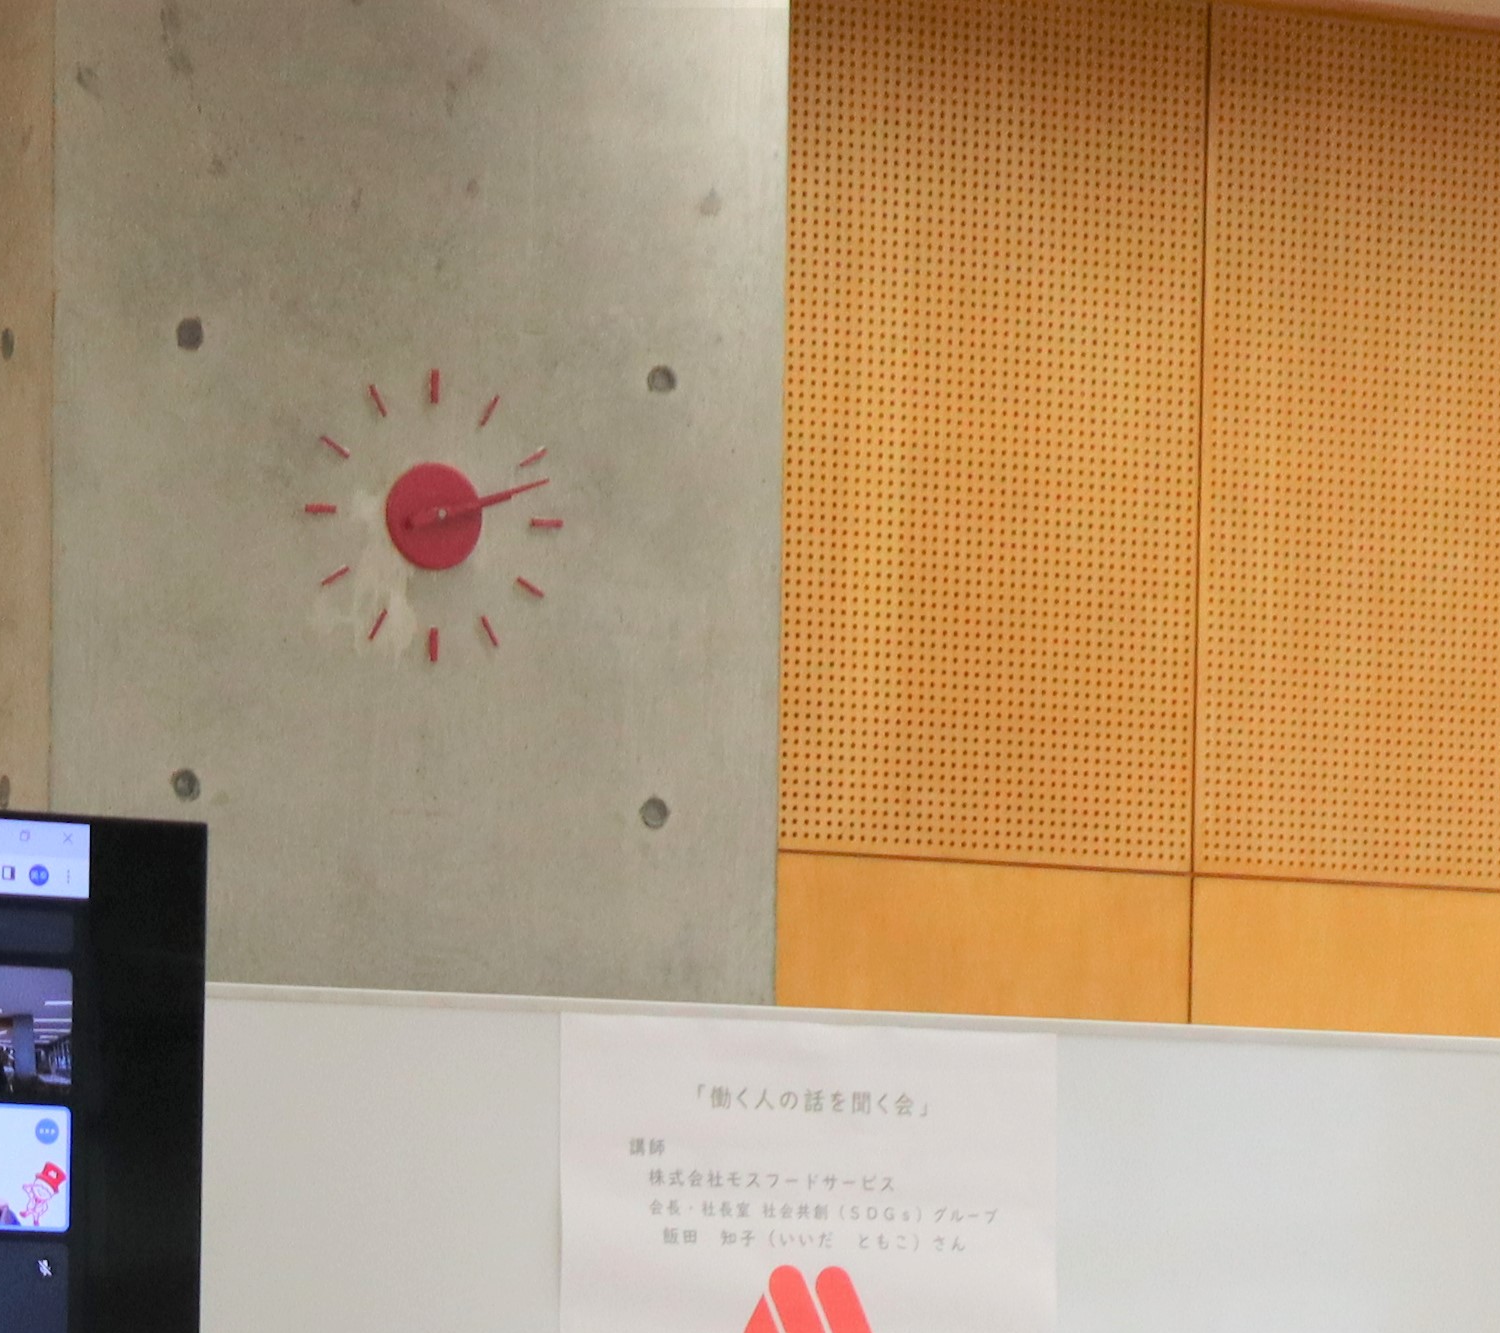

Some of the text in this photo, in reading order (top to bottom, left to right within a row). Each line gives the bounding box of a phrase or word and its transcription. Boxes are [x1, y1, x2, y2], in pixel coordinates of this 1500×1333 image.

[697, 1084, 929, 1118] 「働く人の話を聞く会」
[629, 1138, 665, 1156] 講師
[648, 1169, 895, 1192] 株式会社モスフードサービス
[663, 1227, 698, 1245] 飯田
